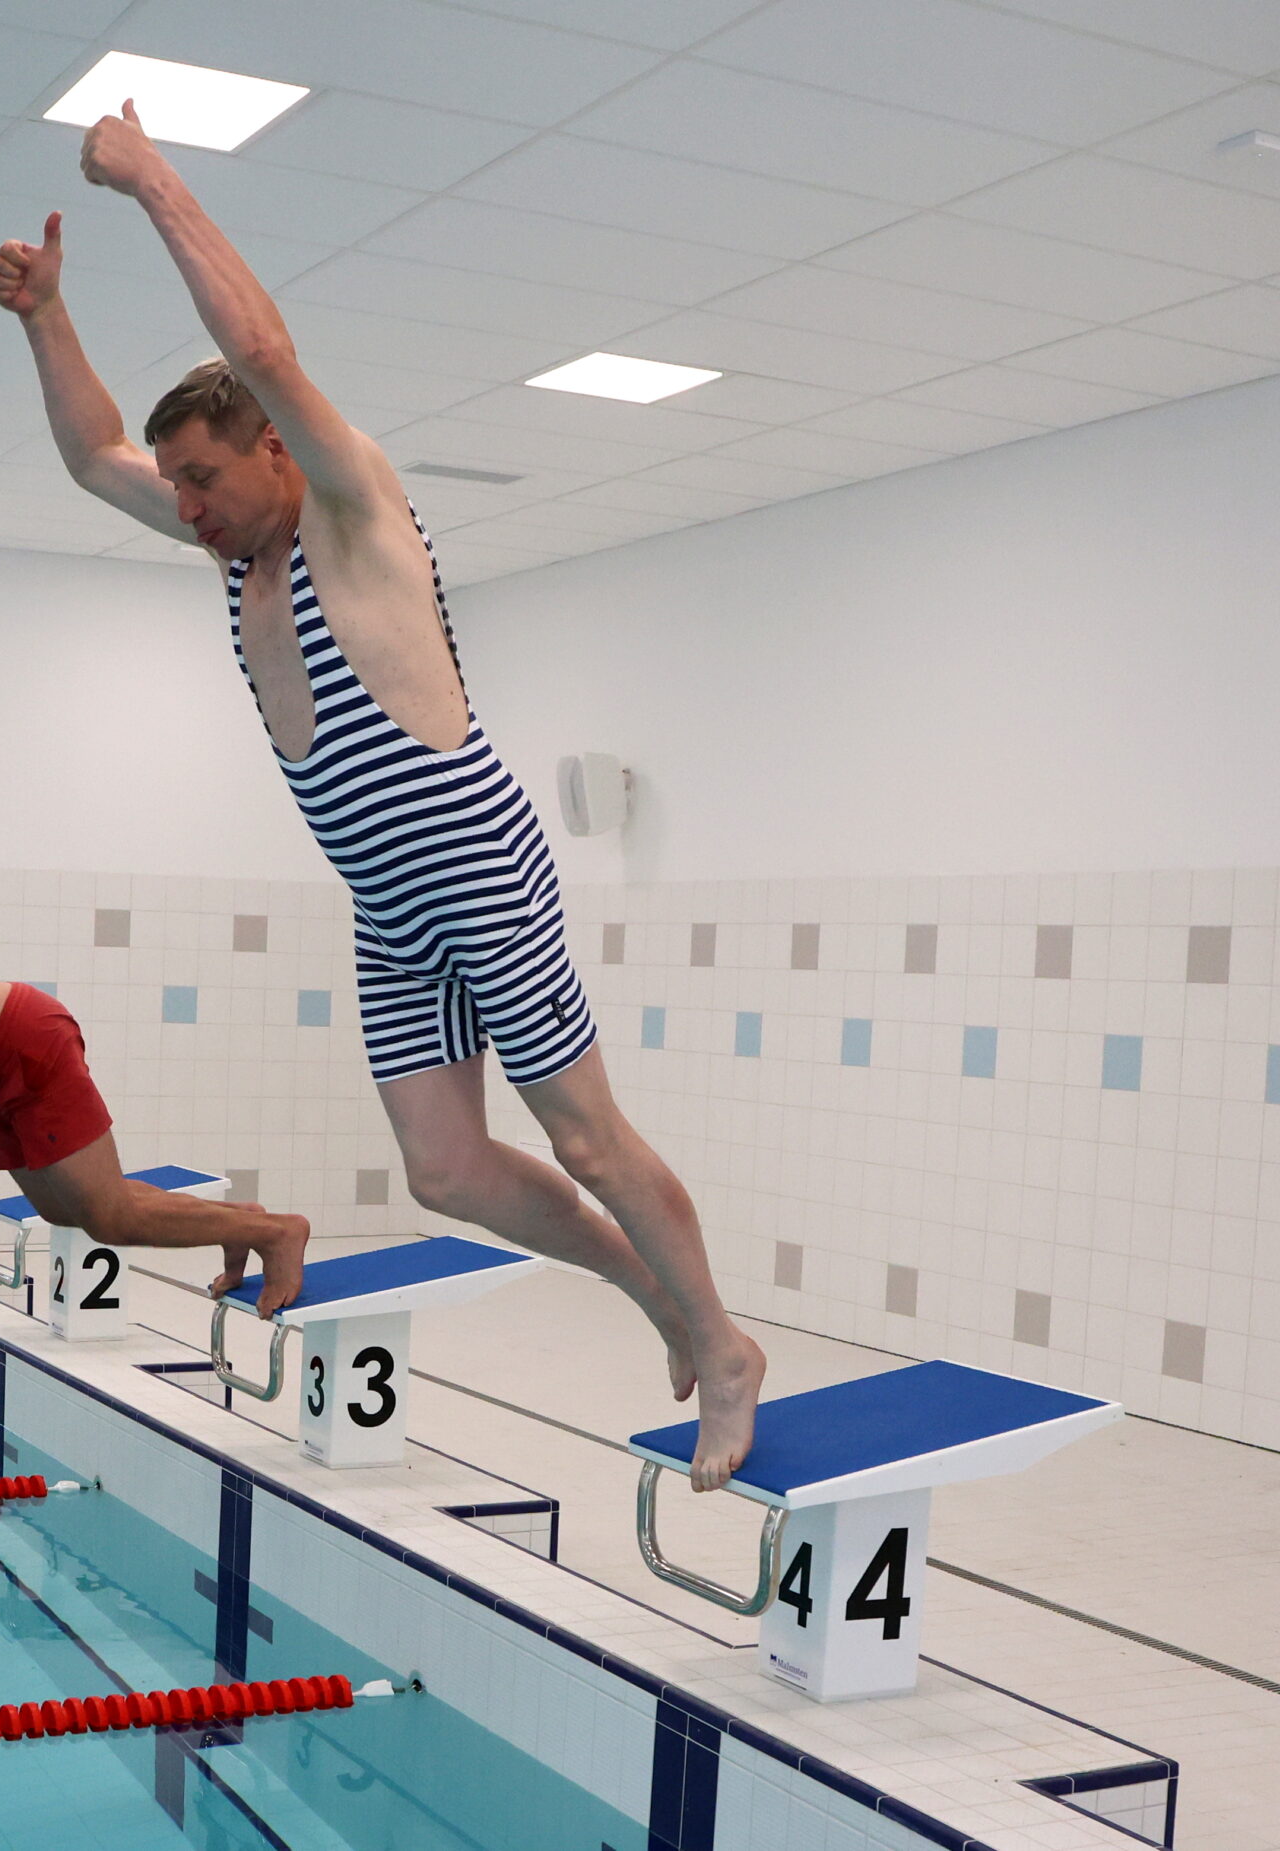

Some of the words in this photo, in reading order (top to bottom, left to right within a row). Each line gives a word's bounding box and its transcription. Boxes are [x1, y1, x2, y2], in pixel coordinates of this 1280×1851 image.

[53, 1256, 65, 1304] 2
[80, 1247, 120, 1310] 2
[307, 1355, 325, 1418] 3
[347, 1346, 397, 1428] 3
[777, 1541, 814, 1629] 4
[845, 1527, 911, 1641] 4
